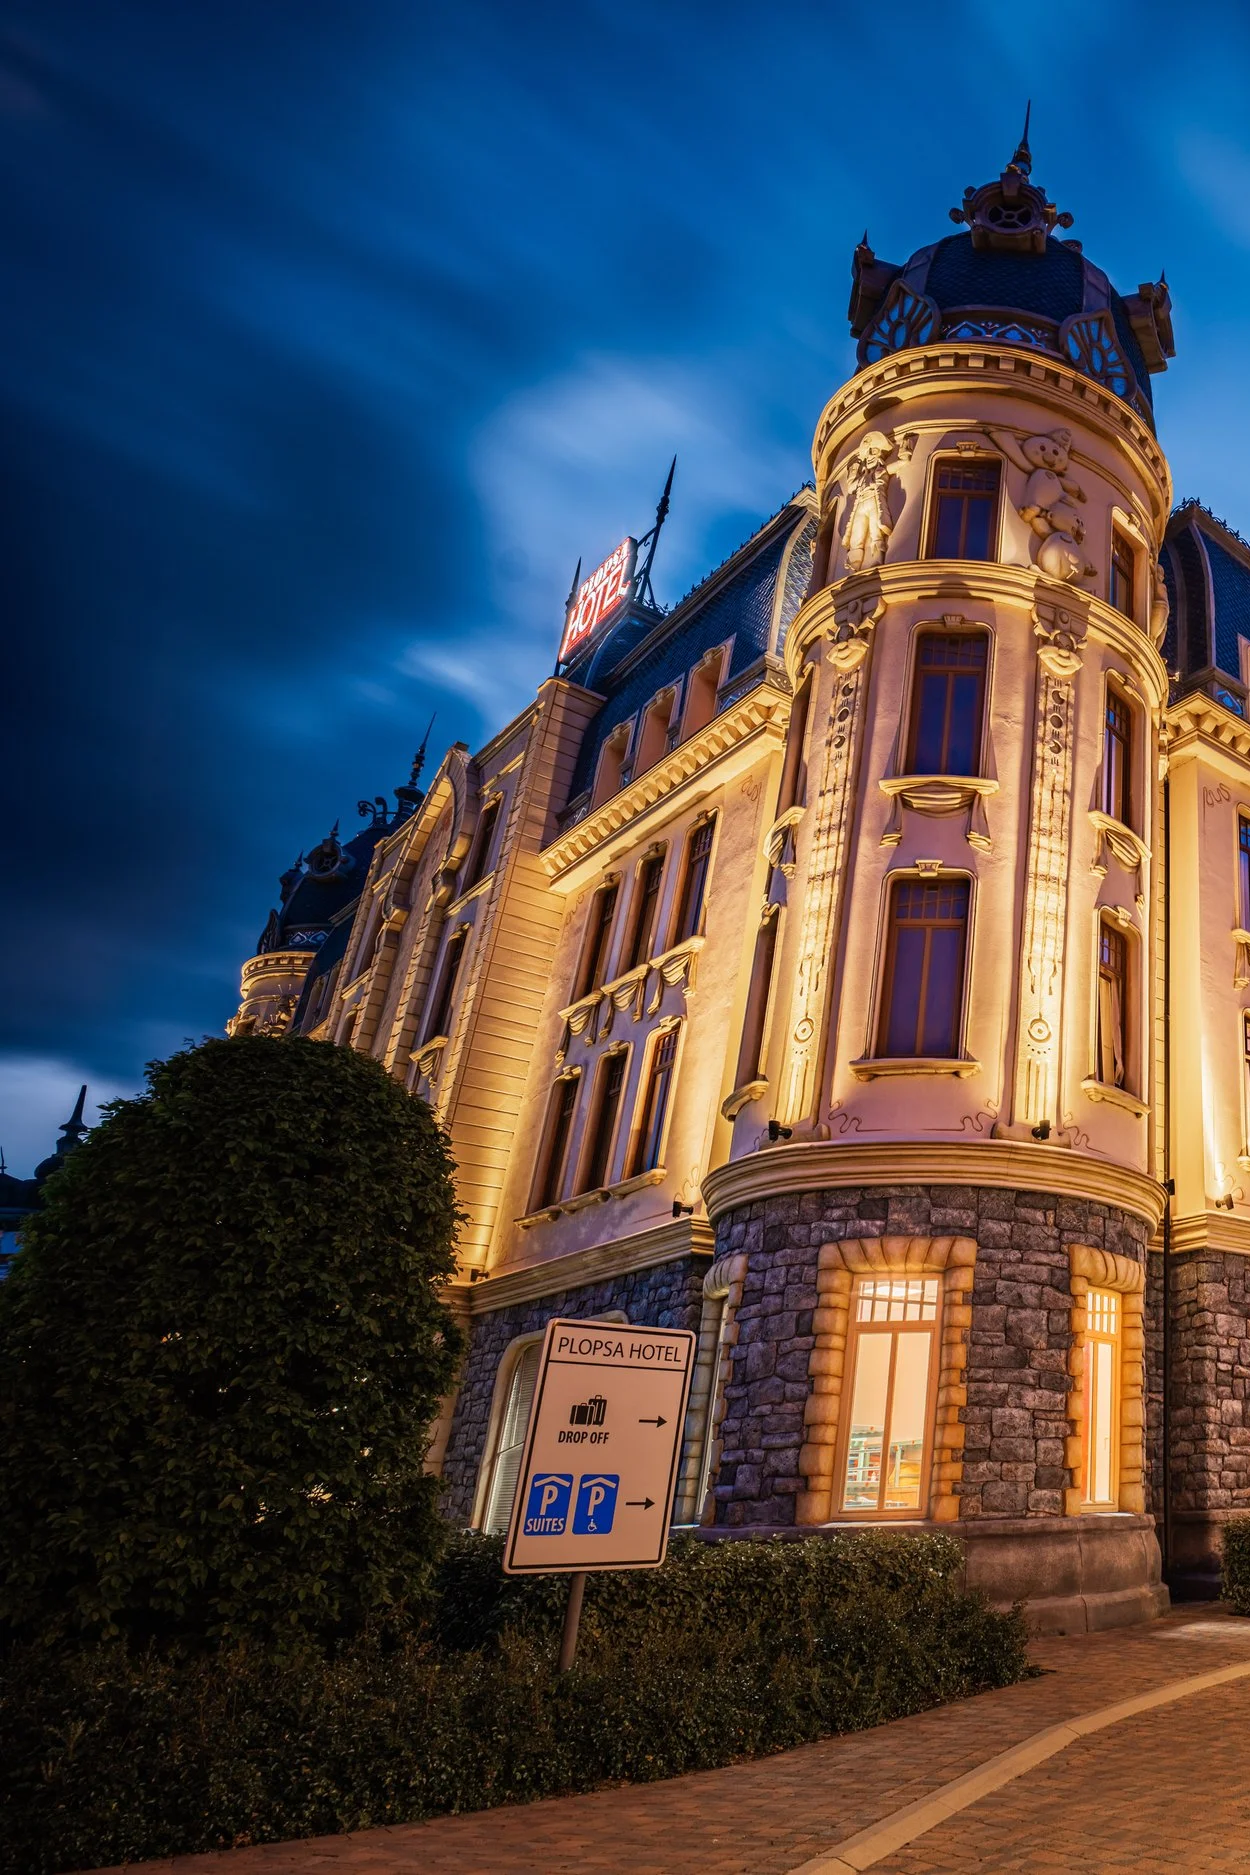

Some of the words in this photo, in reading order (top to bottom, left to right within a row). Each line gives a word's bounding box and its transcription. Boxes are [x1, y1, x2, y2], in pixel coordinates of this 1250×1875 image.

[564, 555, 629, 645] HOTEL
[558, 1336, 624, 1358] PLOPSA
[629, 1343, 682, 1363] HOTEL
[558, 1430, 588, 1443] DROP
[590, 1431, 609, 1444] OFF
[540, 1485, 558, 1516] P
[588, 1486, 605, 1516] P
[526, 1518, 565, 1532] SUITES
